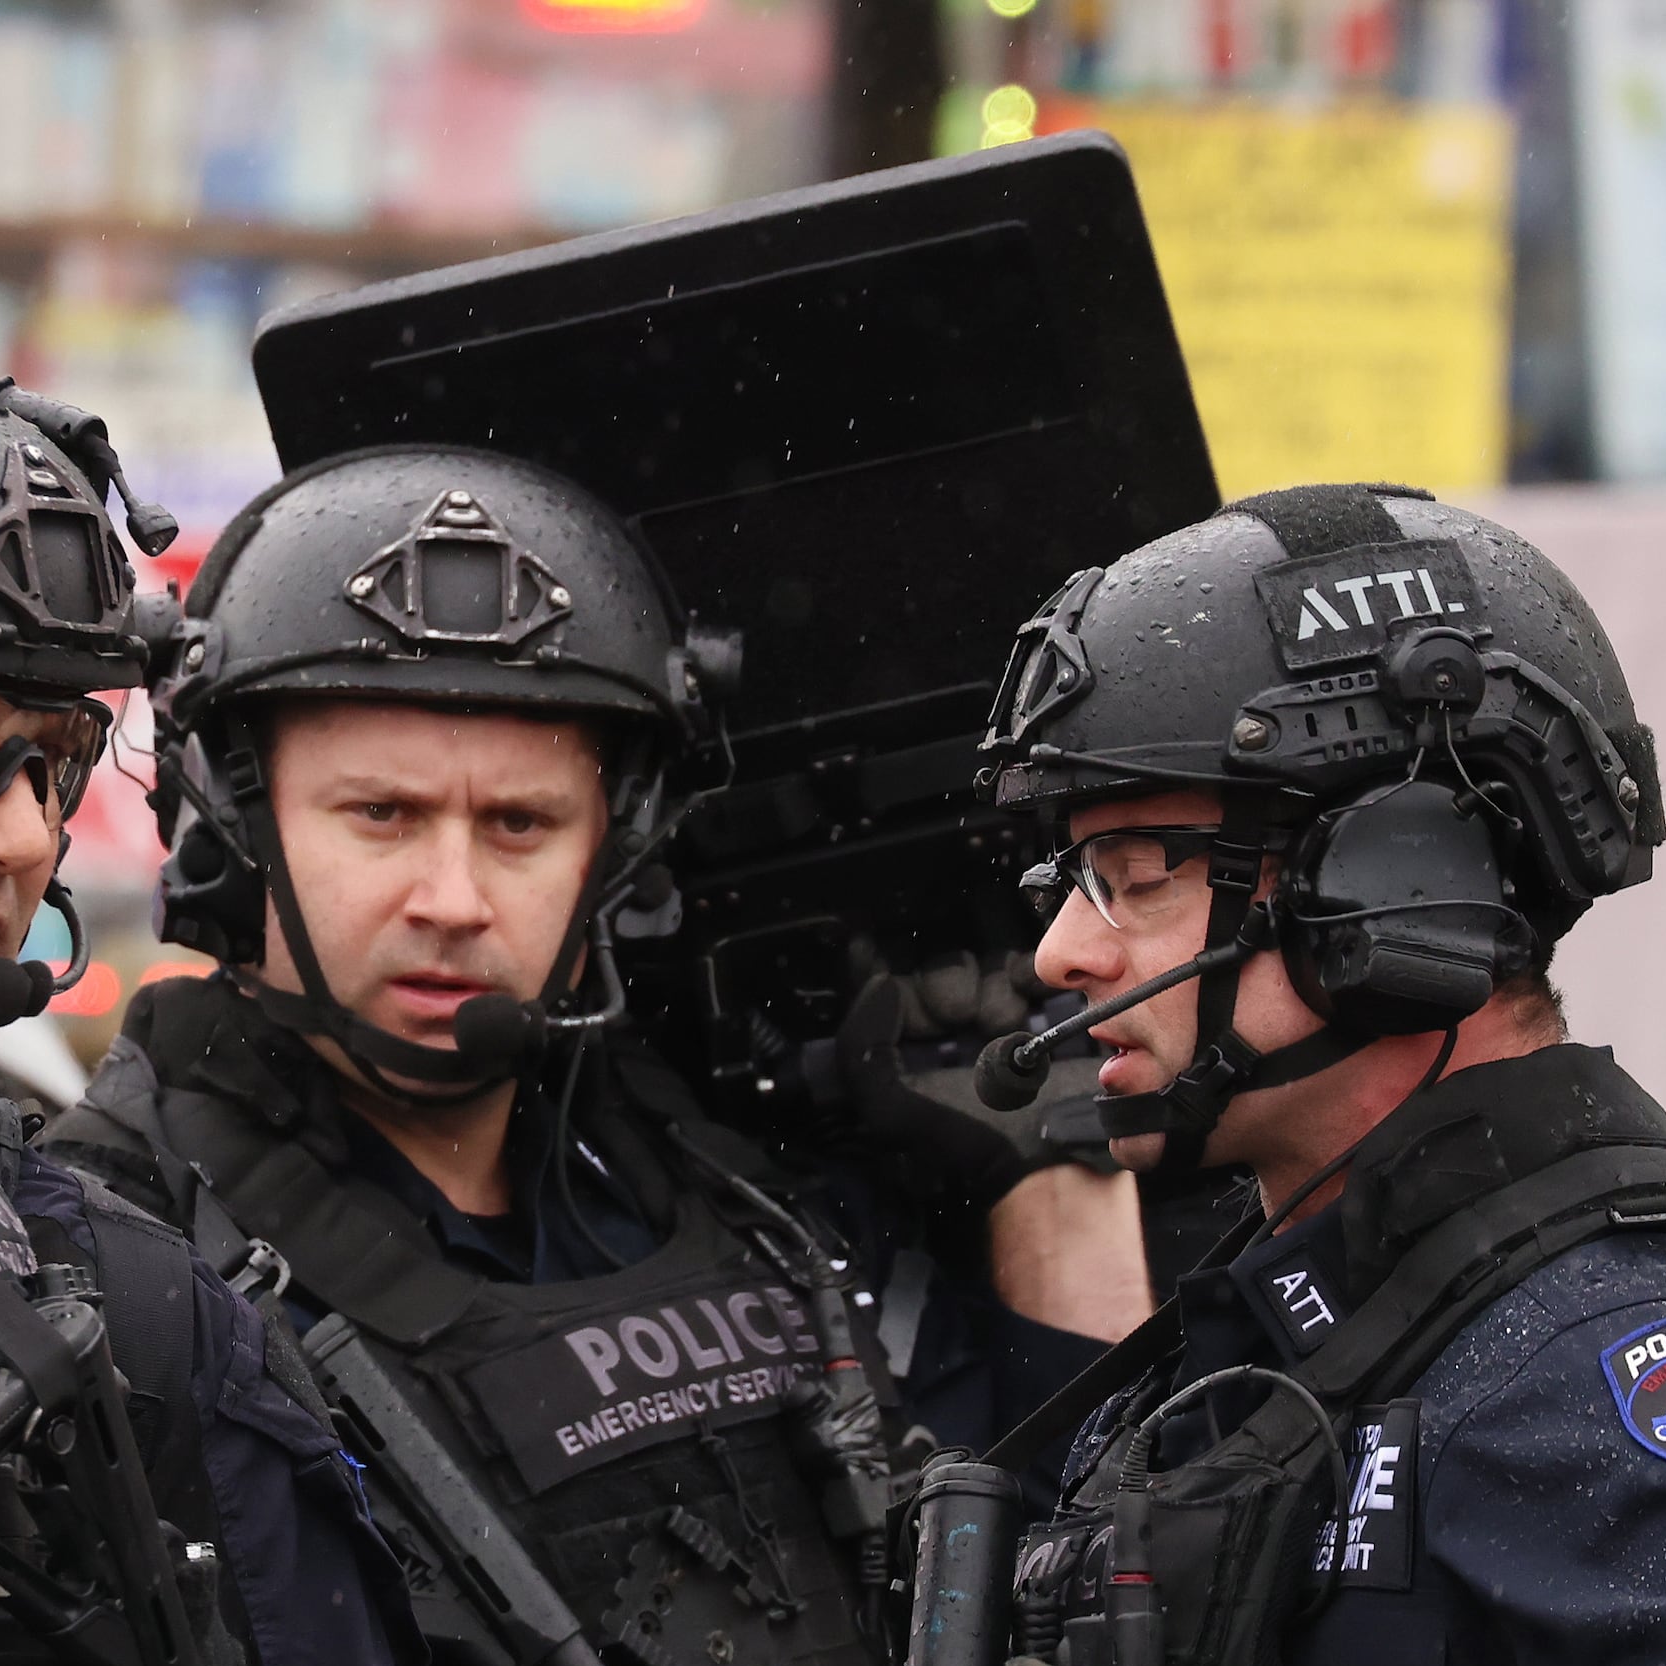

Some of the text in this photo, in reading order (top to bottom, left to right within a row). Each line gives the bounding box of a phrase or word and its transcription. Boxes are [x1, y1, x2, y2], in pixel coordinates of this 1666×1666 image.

[1272, 1270, 1335, 1332] ATT
[564, 1287, 820, 1397] POLICE
[555, 1379, 722, 1457] EMERGENCY
